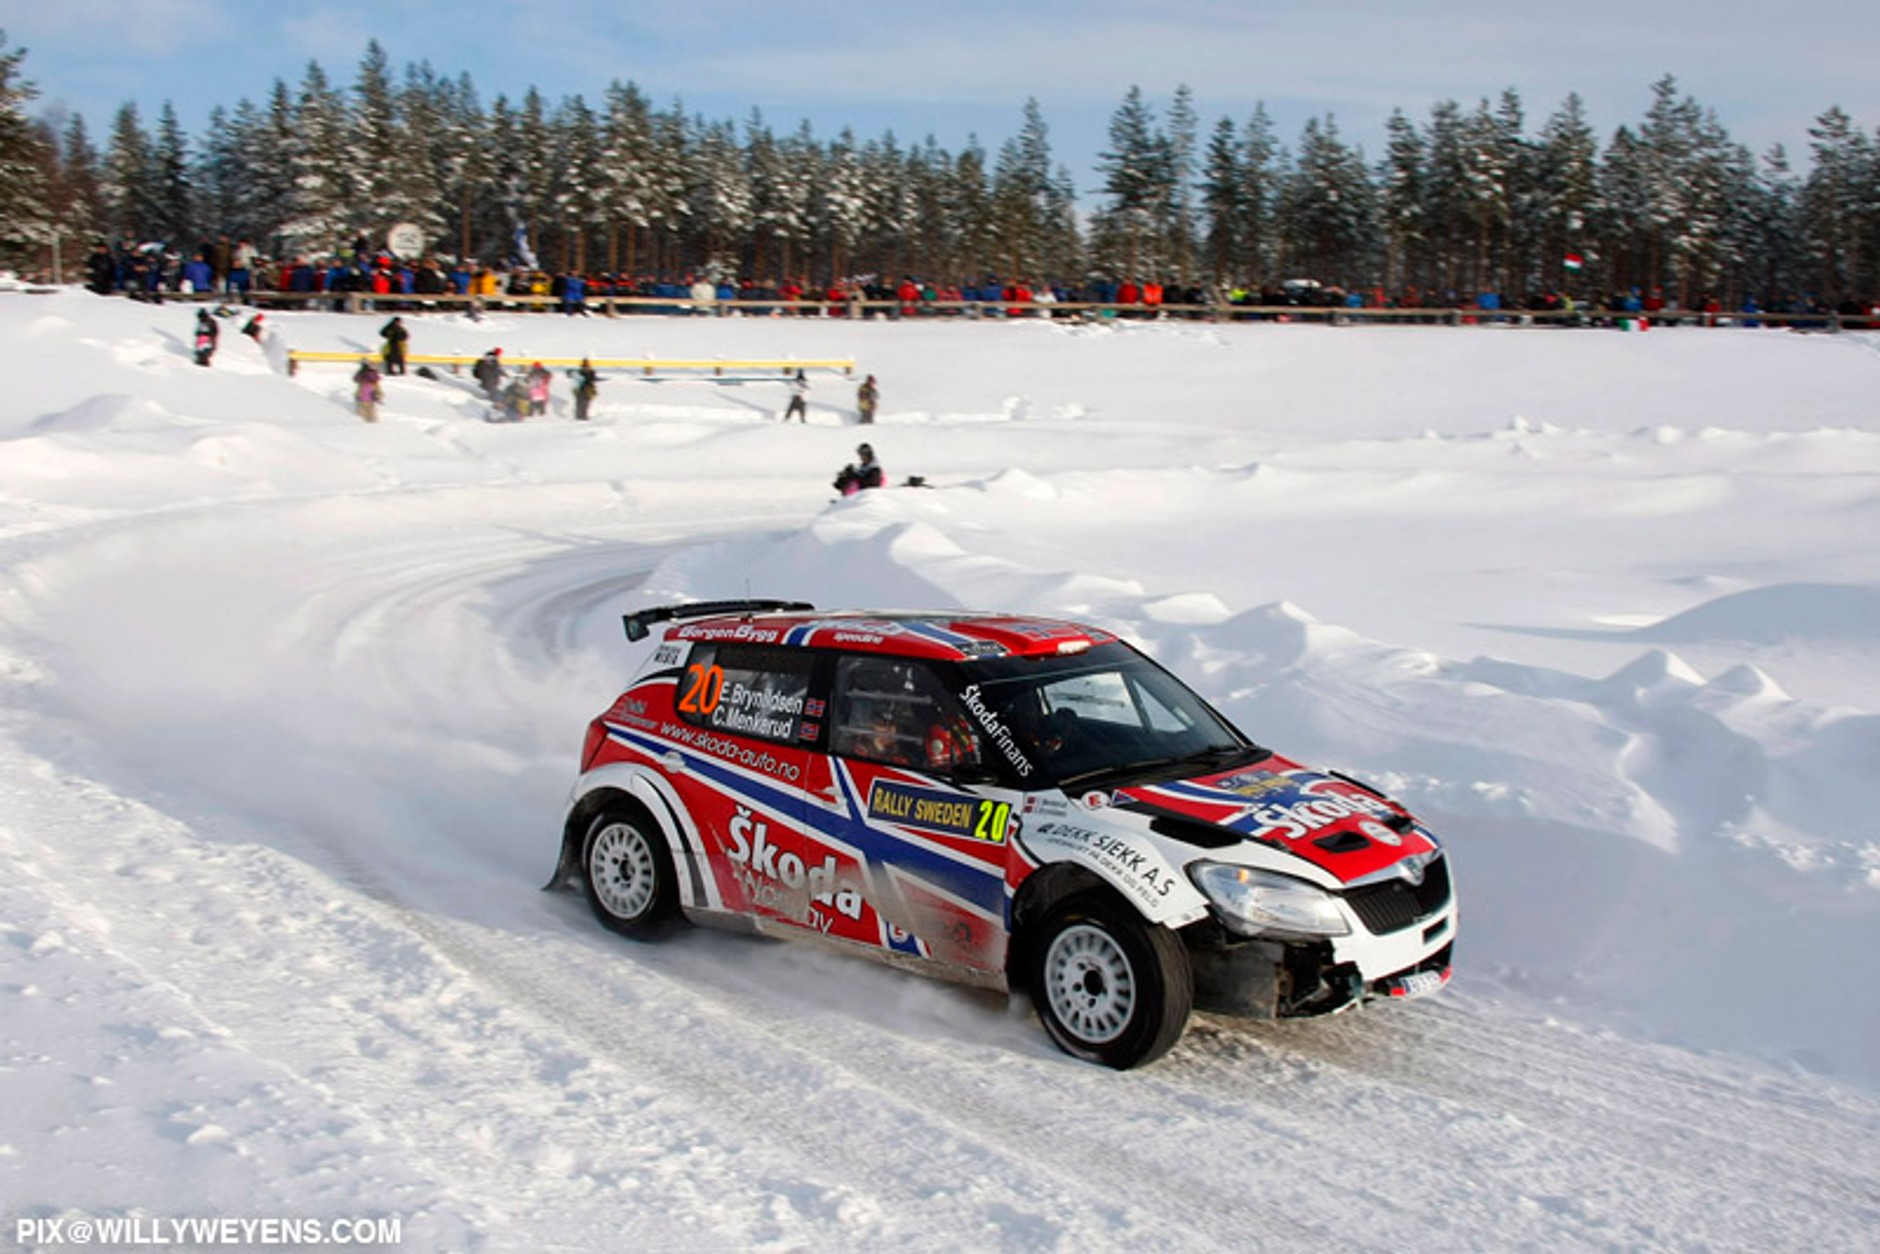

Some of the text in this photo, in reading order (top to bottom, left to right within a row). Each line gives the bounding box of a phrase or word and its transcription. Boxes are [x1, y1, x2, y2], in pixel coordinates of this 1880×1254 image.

[678, 664, 723, 714] 20
[874, 787, 974, 828] RALLY SWEDEN
[975, 800, 1010, 842] 20
[728, 805, 863, 920] Škoda
